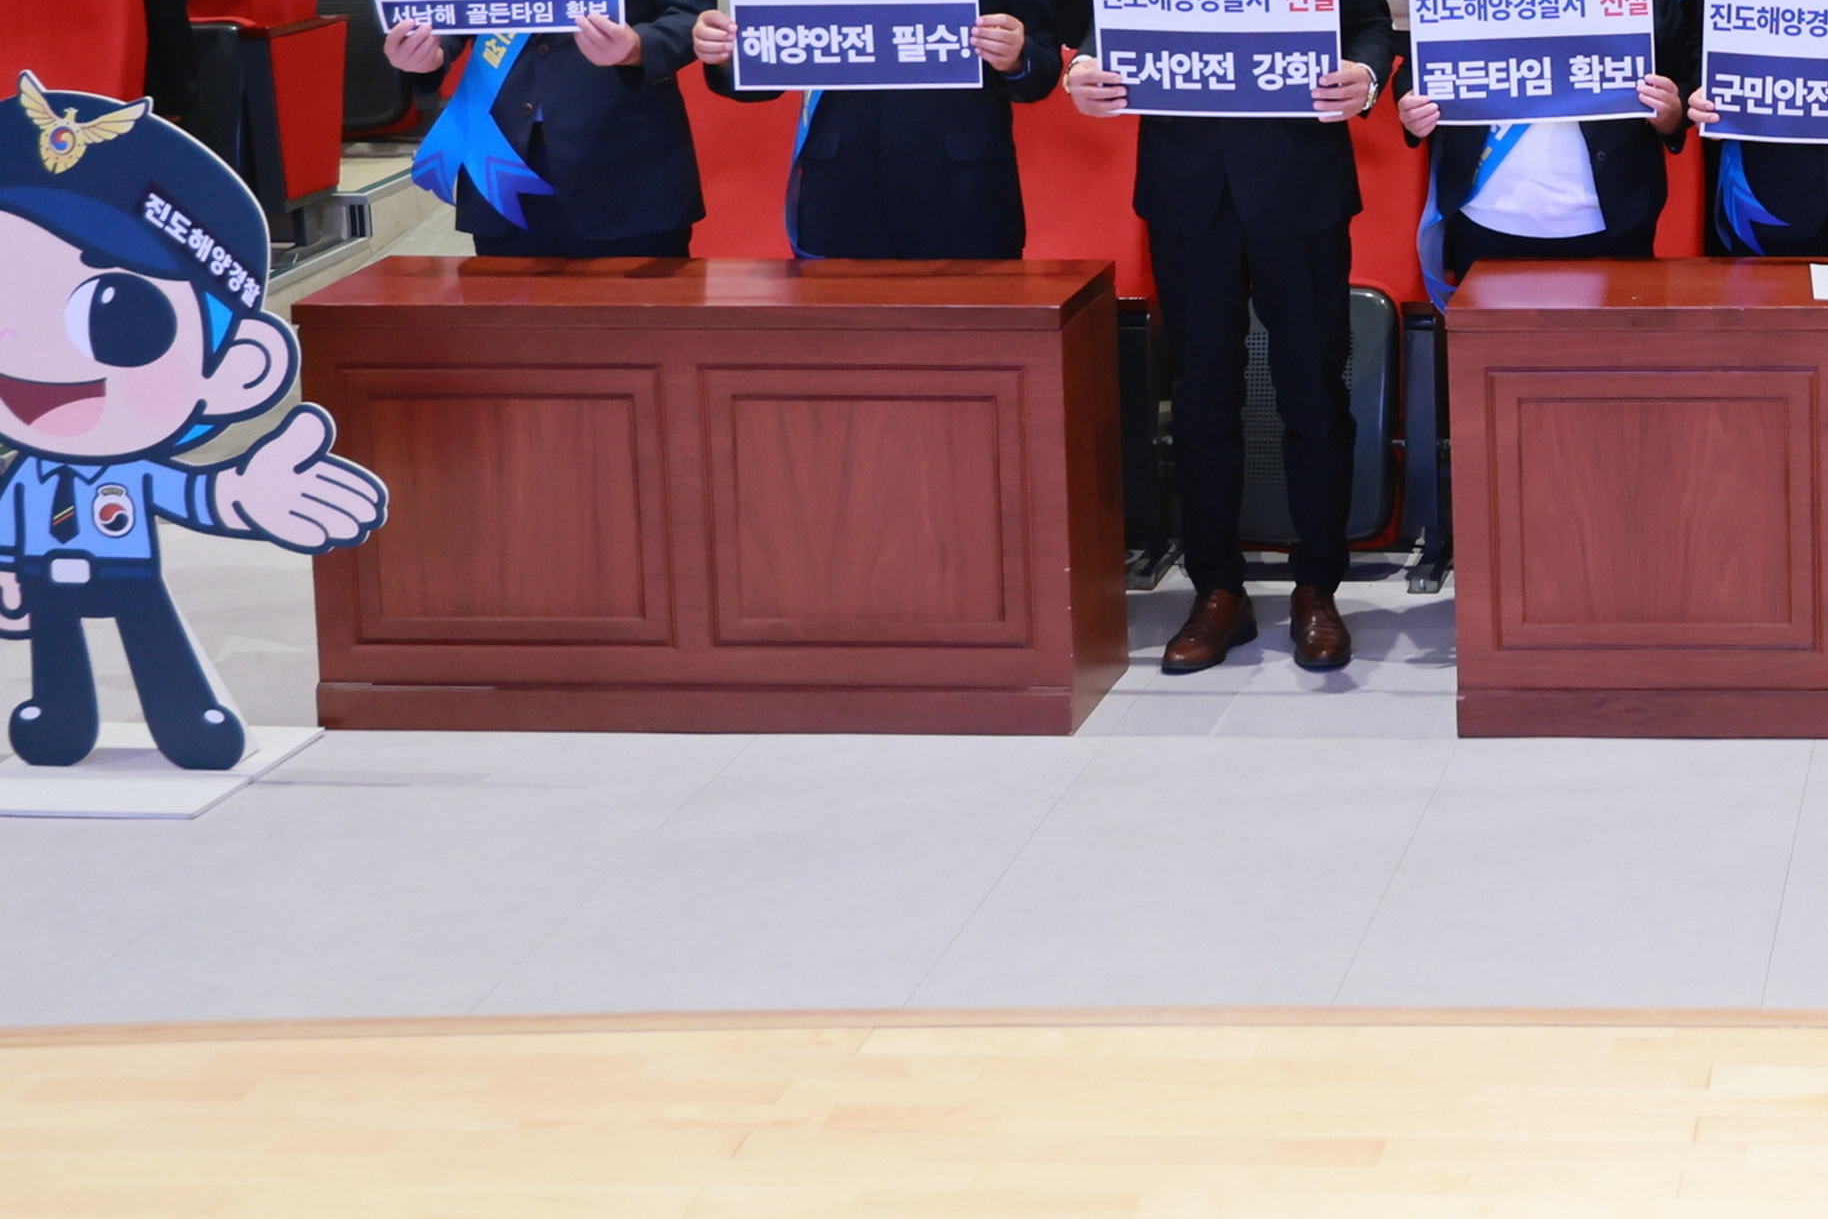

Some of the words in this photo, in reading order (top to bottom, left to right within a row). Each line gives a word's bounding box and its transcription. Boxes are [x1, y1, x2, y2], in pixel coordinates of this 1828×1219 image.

[466, 1, 553, 24] 골든타임
[742, 24, 875, 65] 해양안전
[893, 24, 970, 62] 필수!
[1109, 51, 1235, 90] 도서안전
[1253, 52, 1329, 90] 강화!
[1423, 57, 1552, 100] 골든타임
[1569, 55, 1645, 93] 확보!
[144, 192, 262, 307] 진도해양경찰
